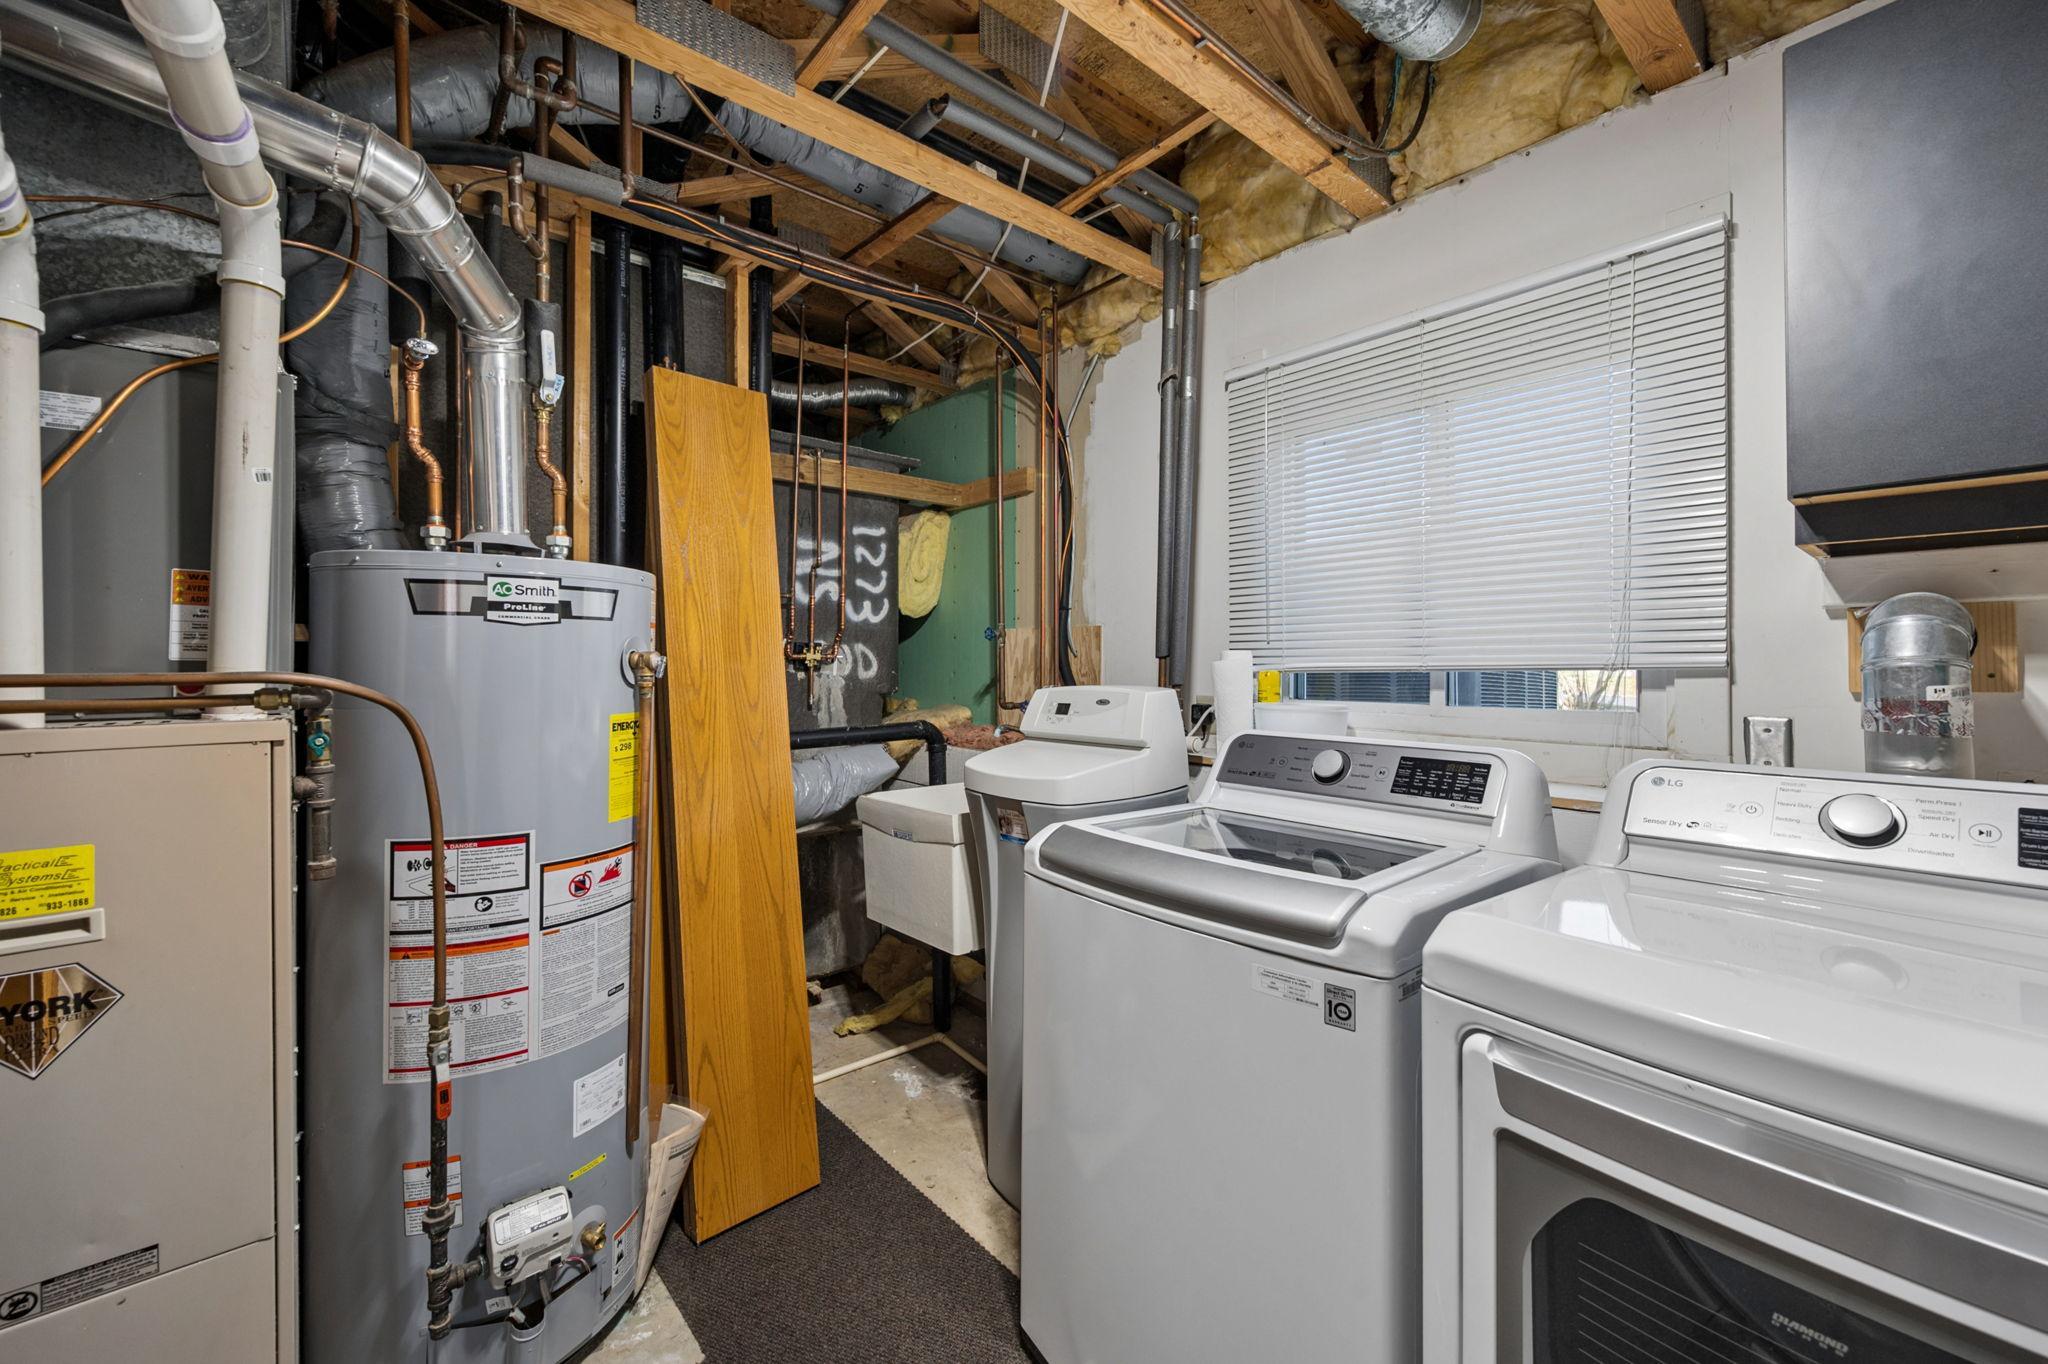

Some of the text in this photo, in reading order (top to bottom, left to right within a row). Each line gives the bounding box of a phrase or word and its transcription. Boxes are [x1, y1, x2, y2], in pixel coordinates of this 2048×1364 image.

[515, 585, 555, 597] Smith
[503, 603, 546, 611] ProLine
[1667, 779, 1684, 788] LG
[1642, 817, 1682, 828] Sensor Dry
[1918, 813, 1942, 822] Speed
[450, 842, 478, 850] DANGER
[1908, 847, 1955, 858] Downloaded
[0, 990, 98, 1026] YORK
[1327, 999, 1352, 1021] 10
[1772, 1312, 1849, 1353] DIAMOND
